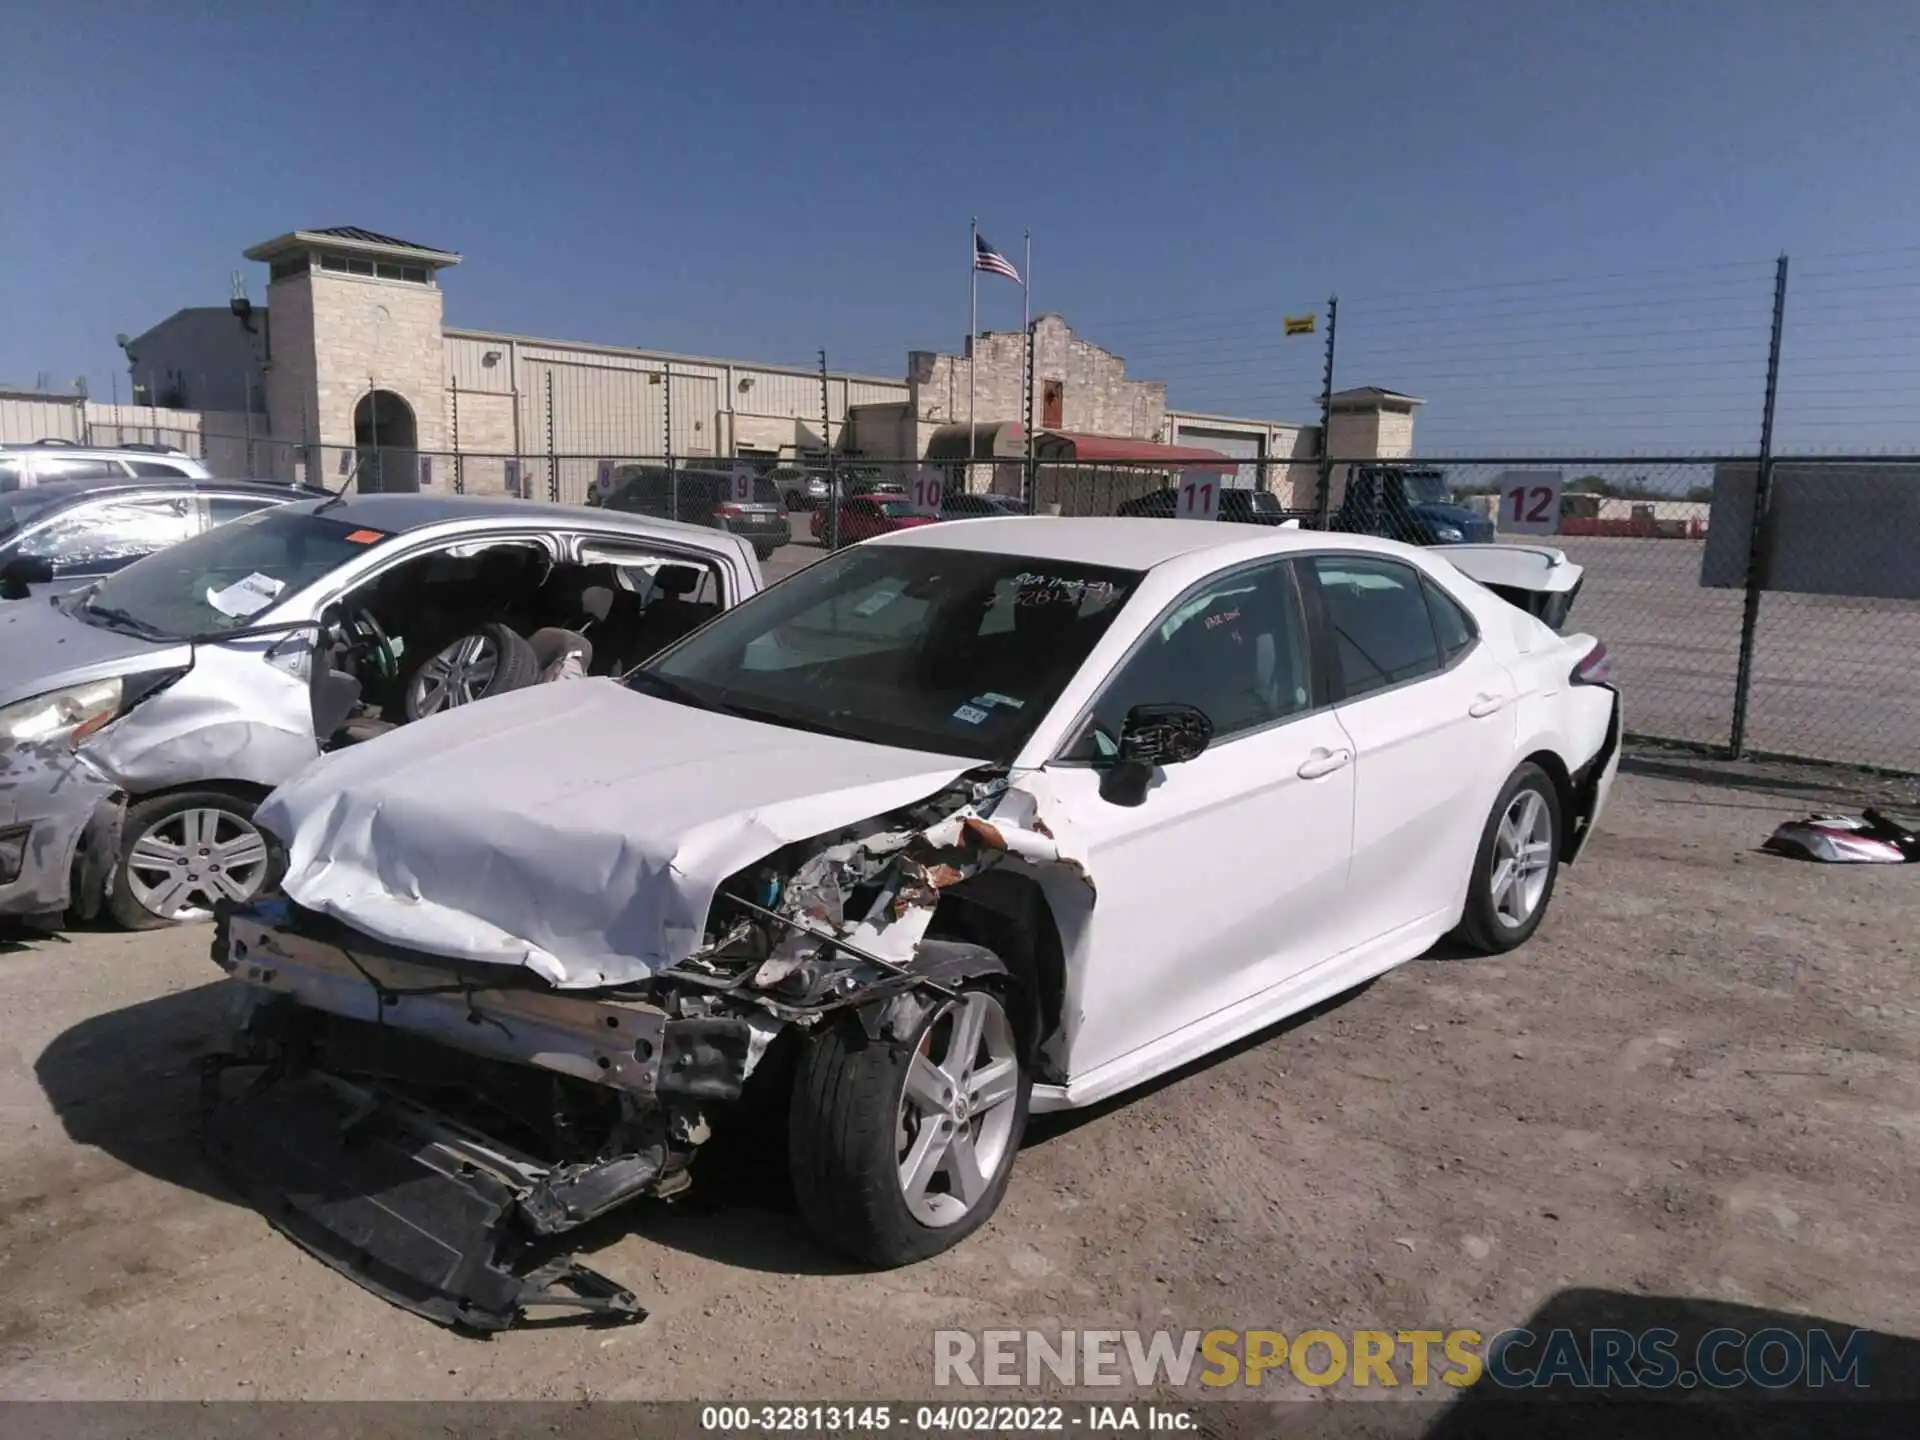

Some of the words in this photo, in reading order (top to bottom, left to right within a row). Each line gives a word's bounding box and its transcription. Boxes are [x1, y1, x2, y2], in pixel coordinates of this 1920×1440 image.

[601, 468, 610, 489] 8
[737, 475, 748, 499] 9
[914, 478, 941, 507] 10
[1184, 482, 1213, 514] 11
[1508, 486, 1553, 523] 12
